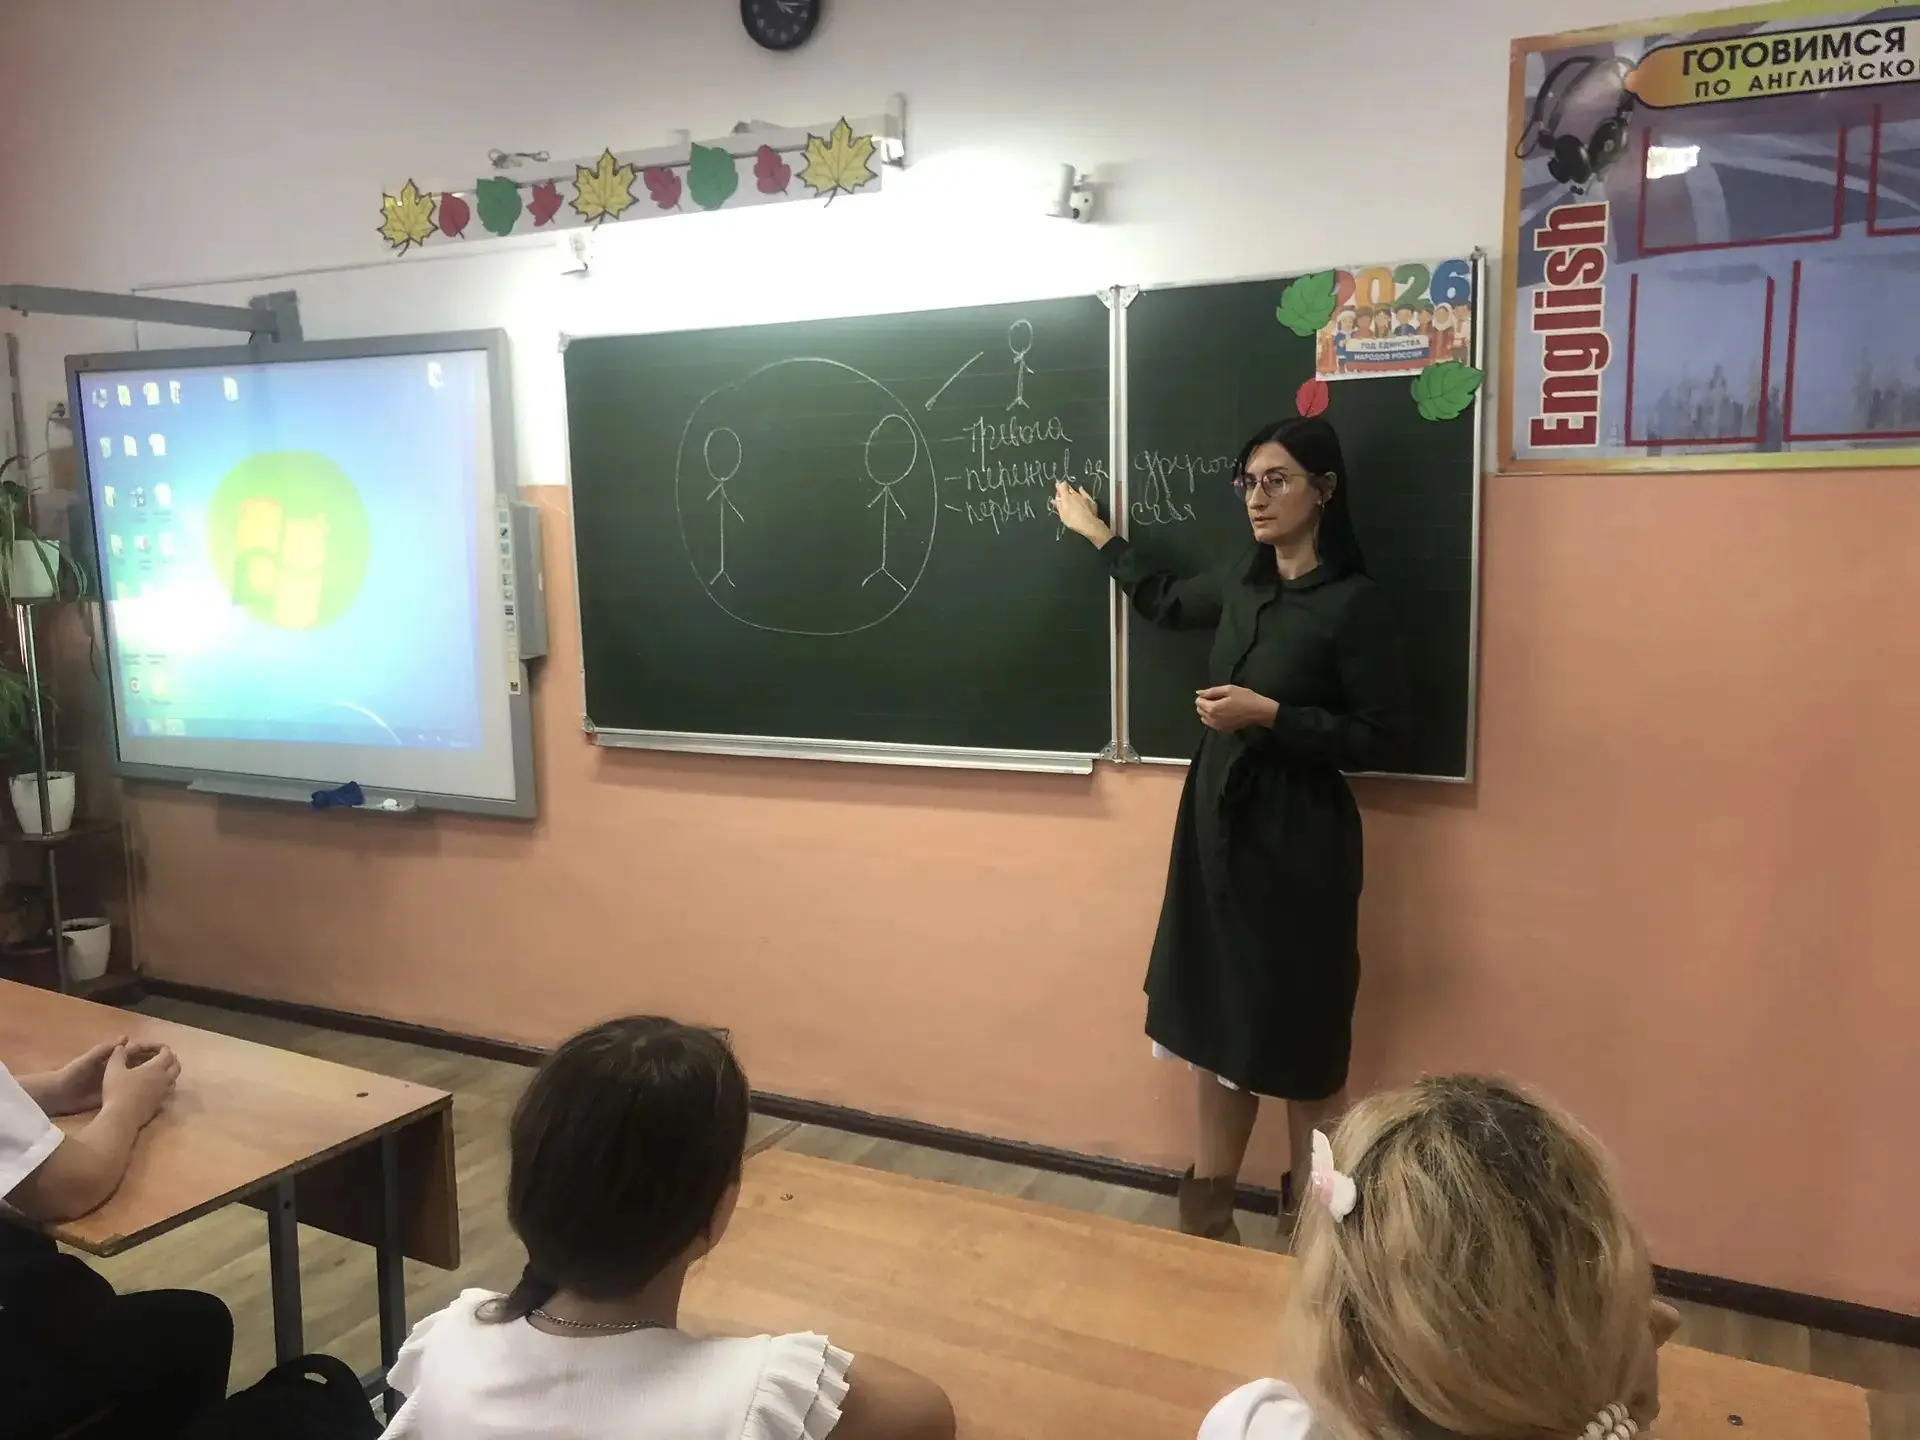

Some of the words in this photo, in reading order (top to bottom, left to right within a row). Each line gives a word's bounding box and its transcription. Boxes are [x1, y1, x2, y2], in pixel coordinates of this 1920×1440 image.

[1682, 26, 1906, 76] ГОТОВИМСЯ
[1694, 78, 1731, 98] ПО
[1748, 58, 1920, 93] АНГЛИЙСКО
[1529, 201, 1612, 448] English
[1354, 352, 1390, 361] НАРОДОВ
